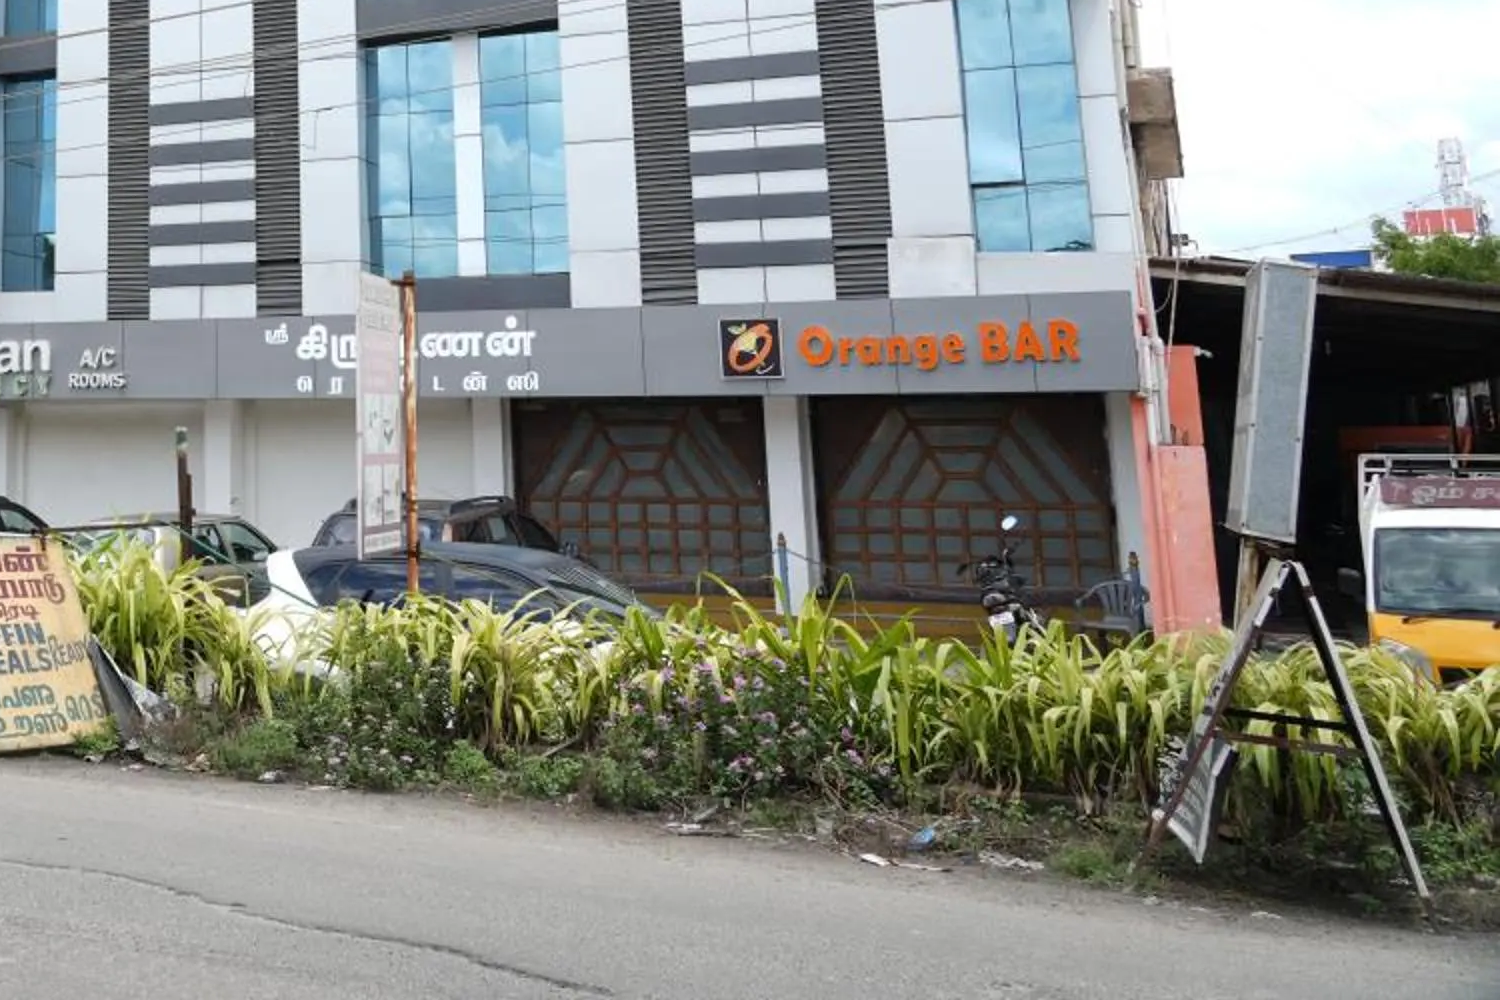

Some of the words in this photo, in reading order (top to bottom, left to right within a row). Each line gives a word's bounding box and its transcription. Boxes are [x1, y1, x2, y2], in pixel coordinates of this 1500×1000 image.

[800, 325, 966, 371] Orange
[979, 318, 1081, 363] BAR
[80, 346, 116, 369] A/C
[69, 373, 126, 390] ROOMS
